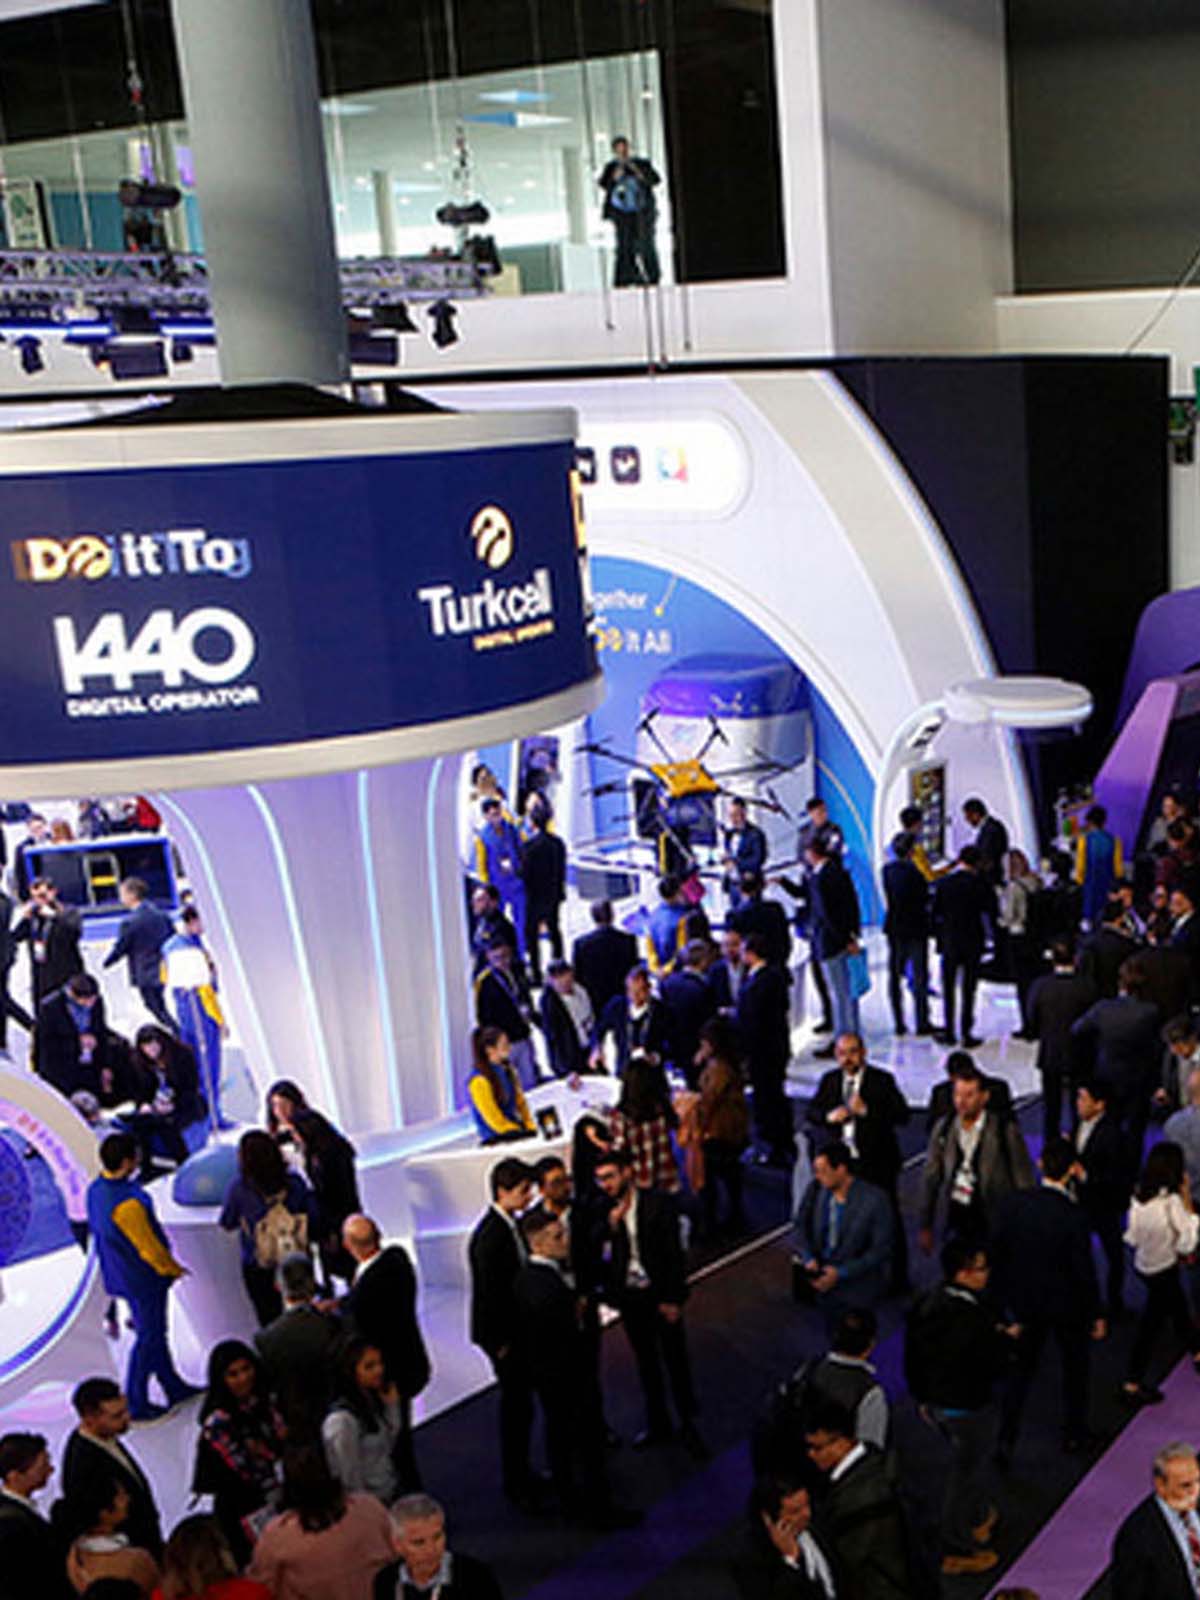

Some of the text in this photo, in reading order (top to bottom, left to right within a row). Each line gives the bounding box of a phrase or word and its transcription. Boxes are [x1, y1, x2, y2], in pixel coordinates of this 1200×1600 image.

[417, 567, 554, 636] Turkcell
[66, 685, 260, 717] DIGITAL OPERATOR
